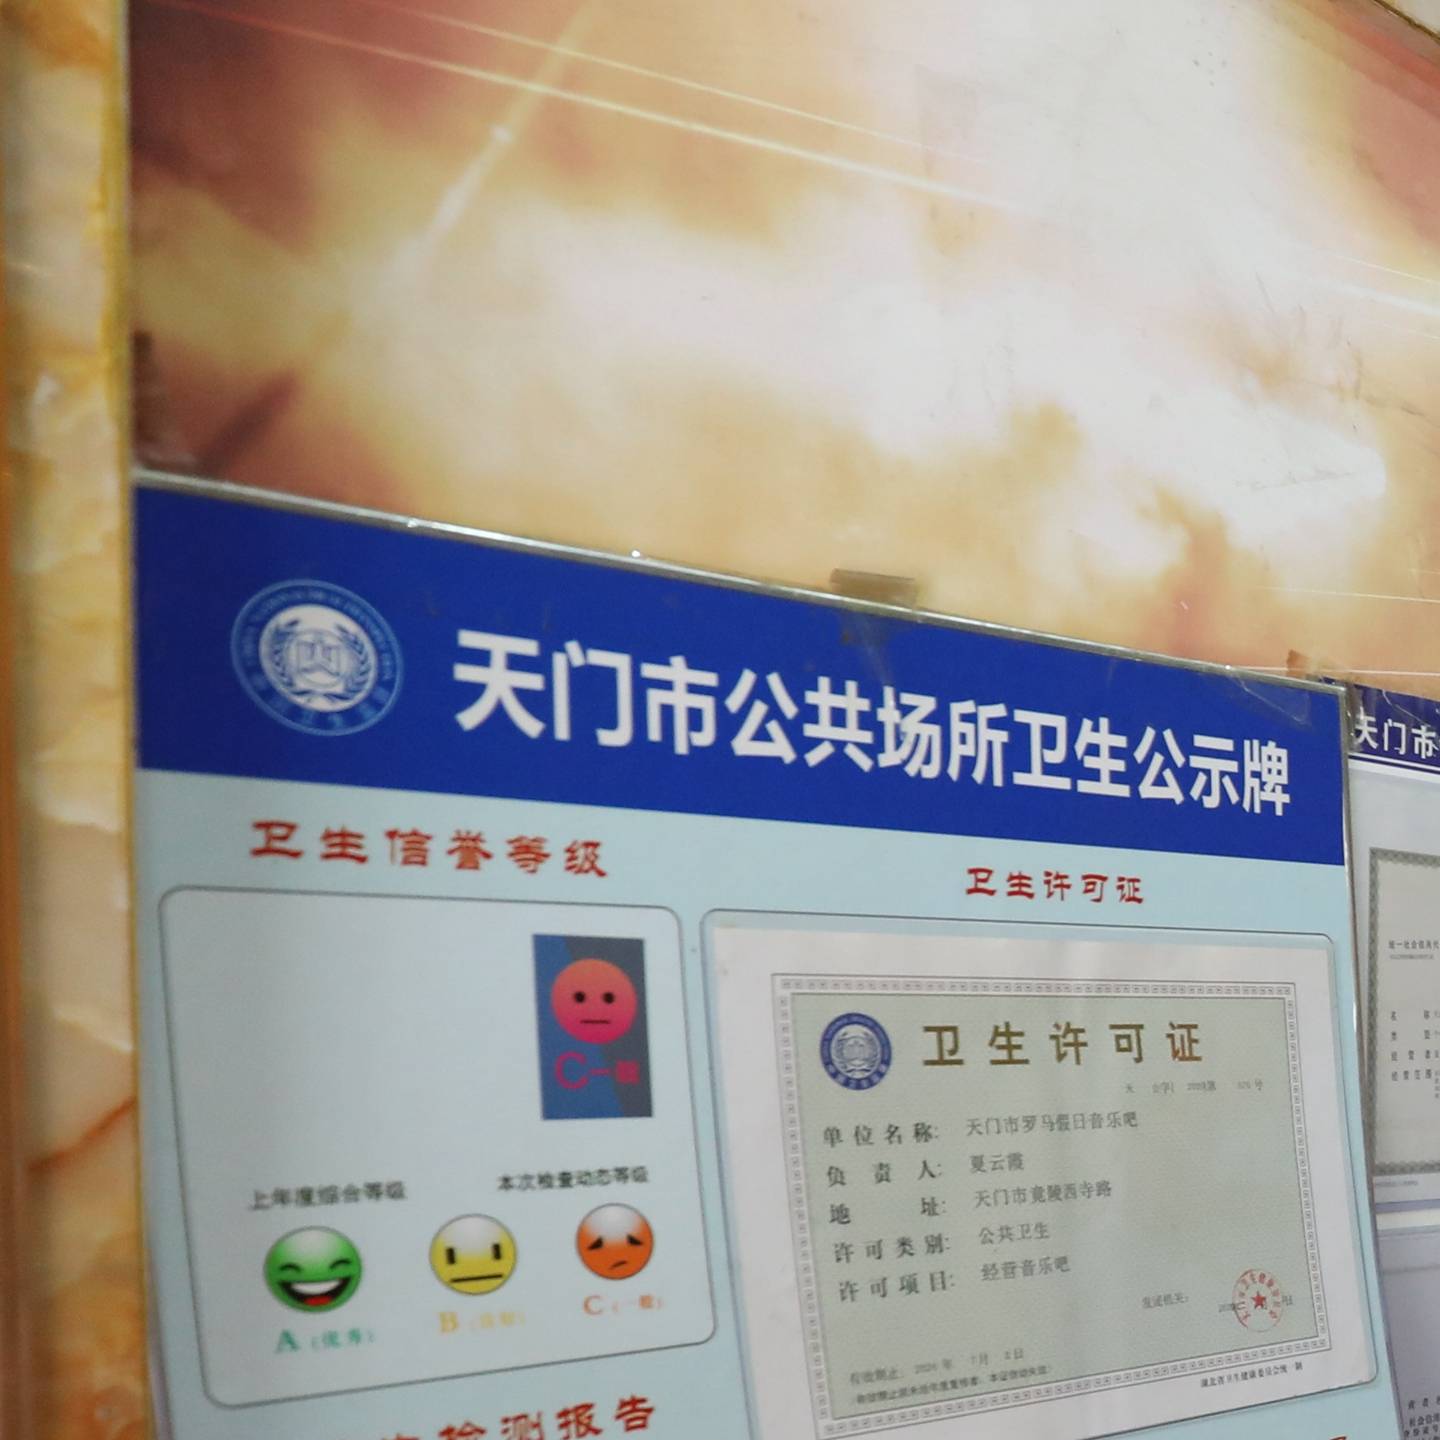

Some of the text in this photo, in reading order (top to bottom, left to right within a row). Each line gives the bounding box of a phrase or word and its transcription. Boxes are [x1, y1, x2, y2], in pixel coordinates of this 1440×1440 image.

[452, 628, 1292, 817] 天门市公共场所卫生公示牌
[250, 820, 608, 879] 卫生信誉等级
[965, 867, 1145, 905] 卫生许可证
[922, 1020, 1203, 1067] 卫生许可证
[966, 1110, 1139, 1137] 天门市罗马假日音乐吧
[978, 1221, 1050, 1246] 公共卫生
[582, 1295, 603, 1315] C
[438, 1311, 460, 1334] B
[275, 1329, 300, 1354] A
